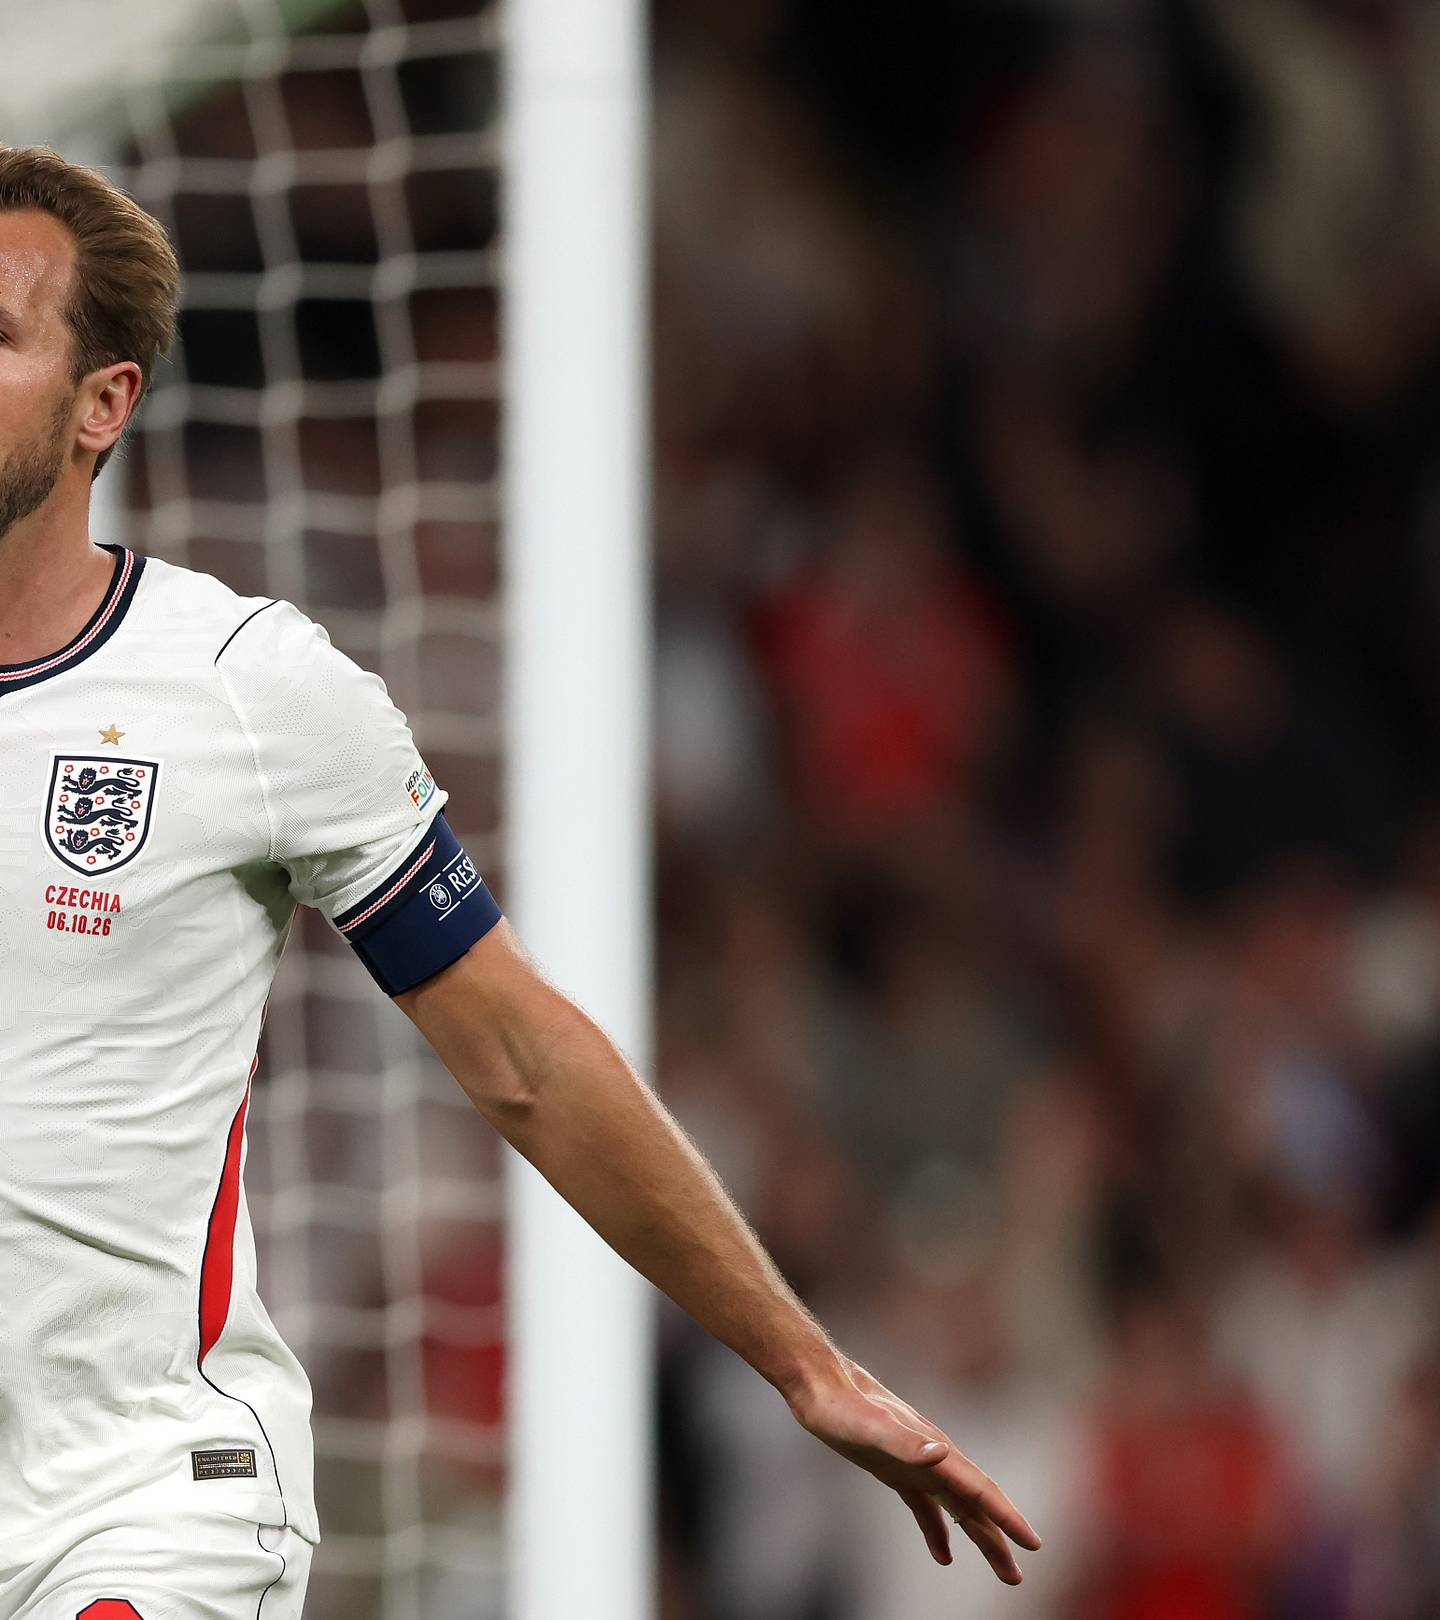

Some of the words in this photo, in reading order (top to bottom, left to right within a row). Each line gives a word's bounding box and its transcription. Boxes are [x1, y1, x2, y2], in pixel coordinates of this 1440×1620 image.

[405, 770, 420, 792] UEFA
[45, 885, 121, 913] CZECHIA
[47, 911, 111, 936] 06.10.26
